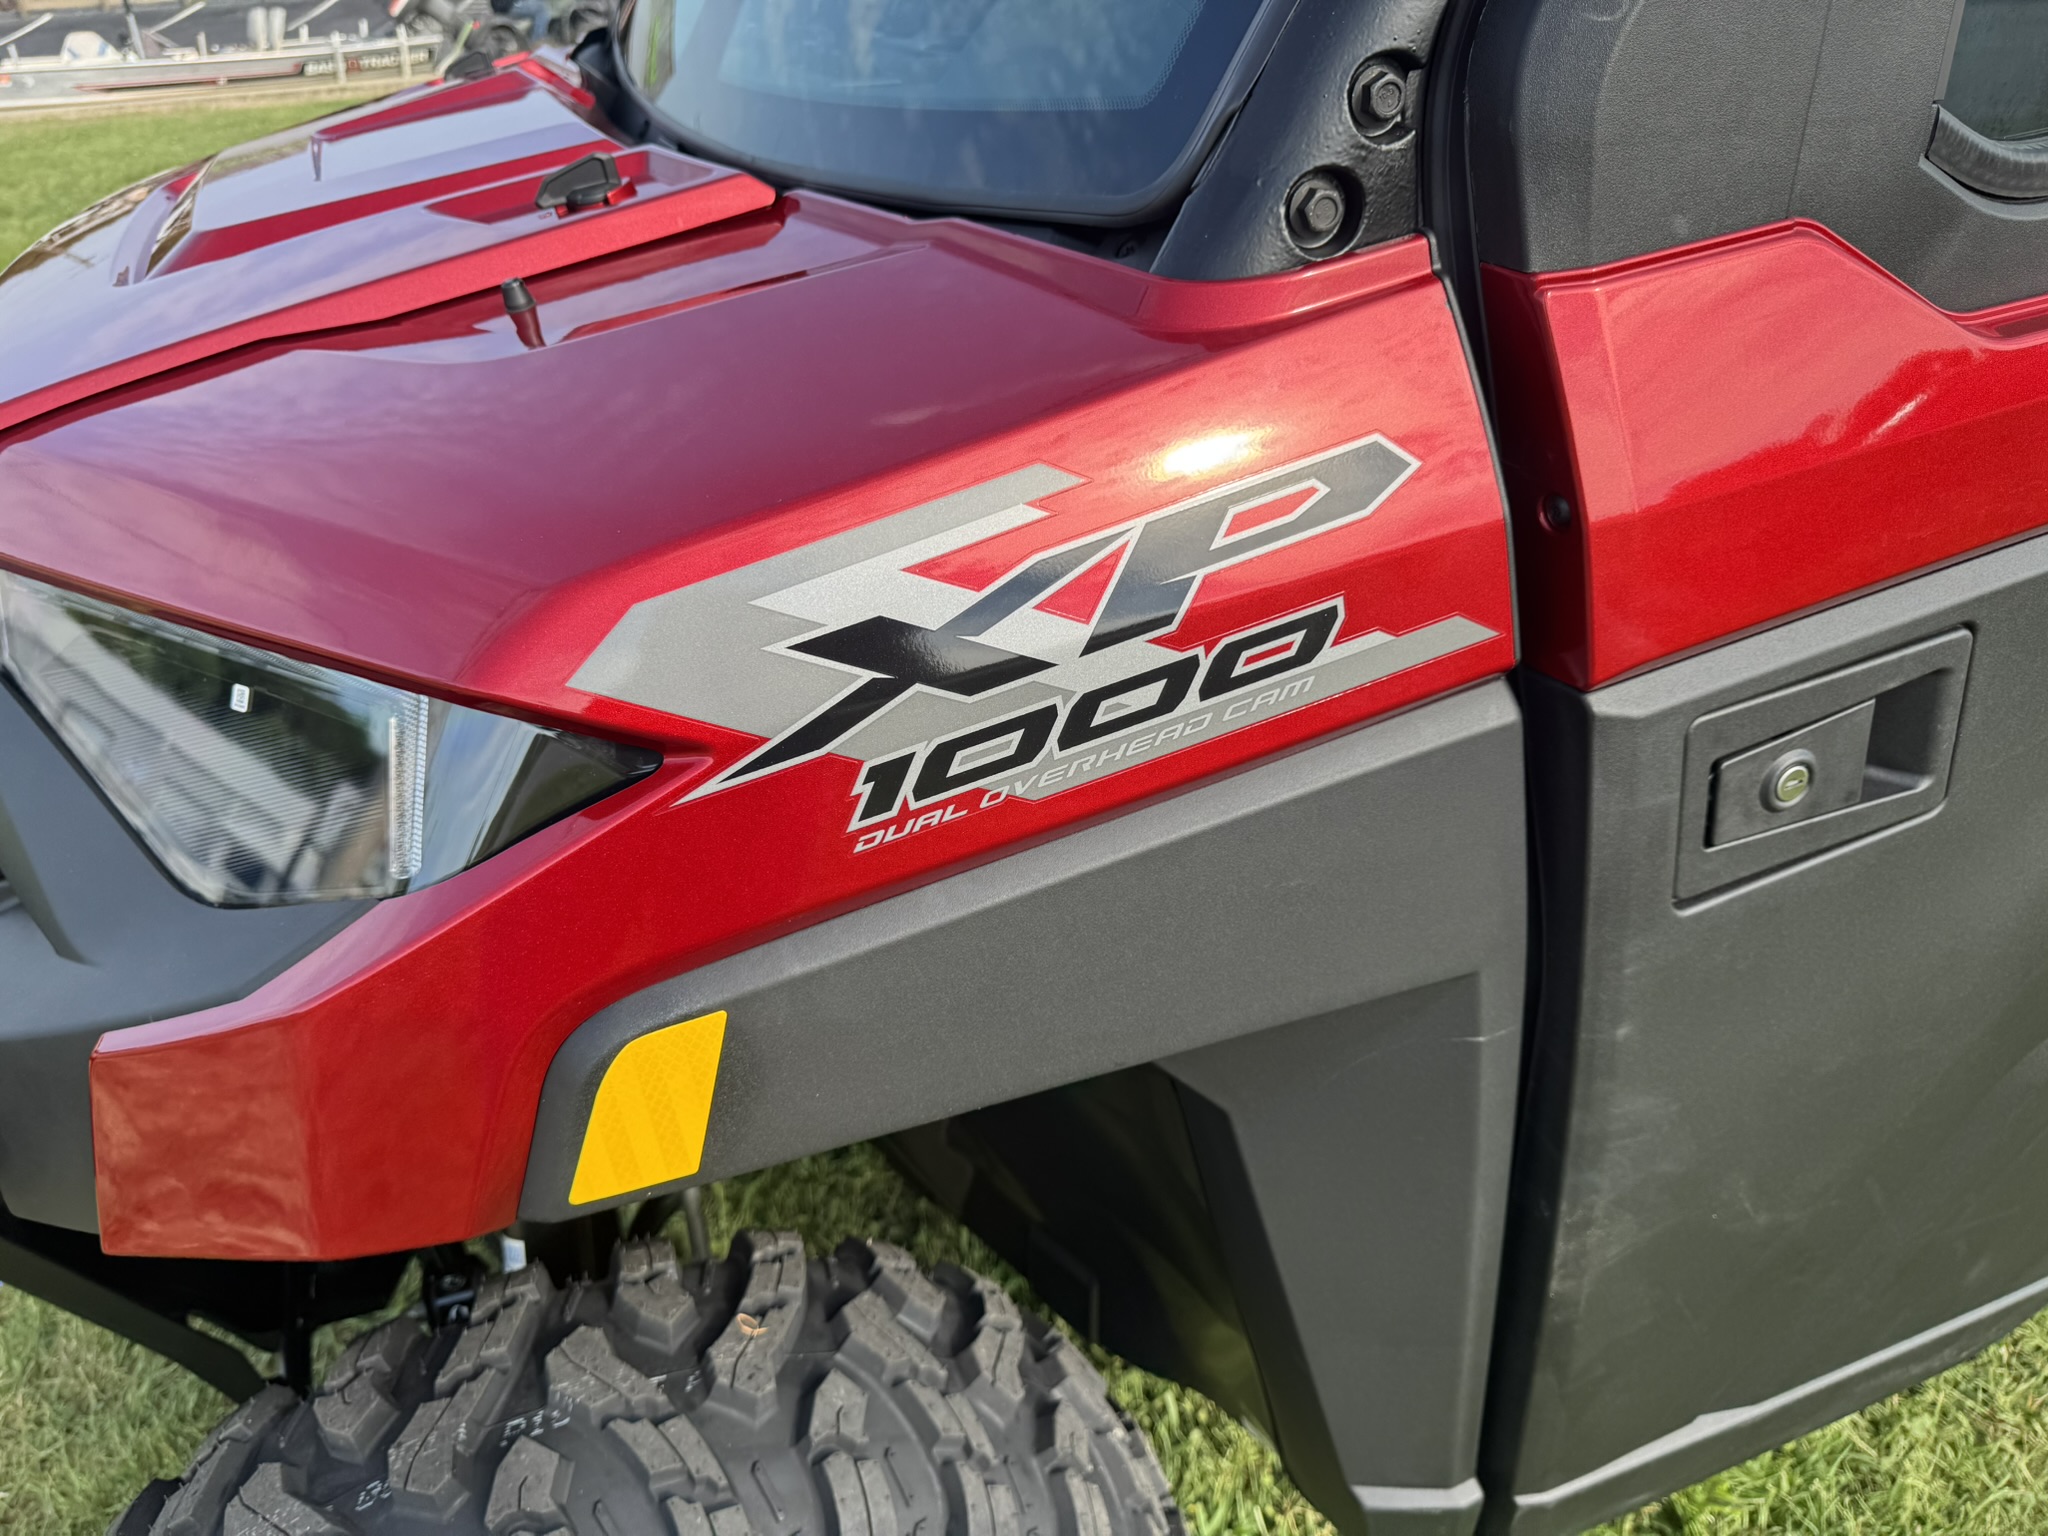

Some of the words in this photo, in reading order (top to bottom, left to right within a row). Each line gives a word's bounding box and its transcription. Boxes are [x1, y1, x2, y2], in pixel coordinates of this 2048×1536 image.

[672, 434, 1420, 803] XP
[848, 594, 1346, 833] 1000
[853, 804, 969, 854] DUAL
[979, 711, 1213, 809] OVERHEAD
[1222, 675, 1316, 722] CAM
